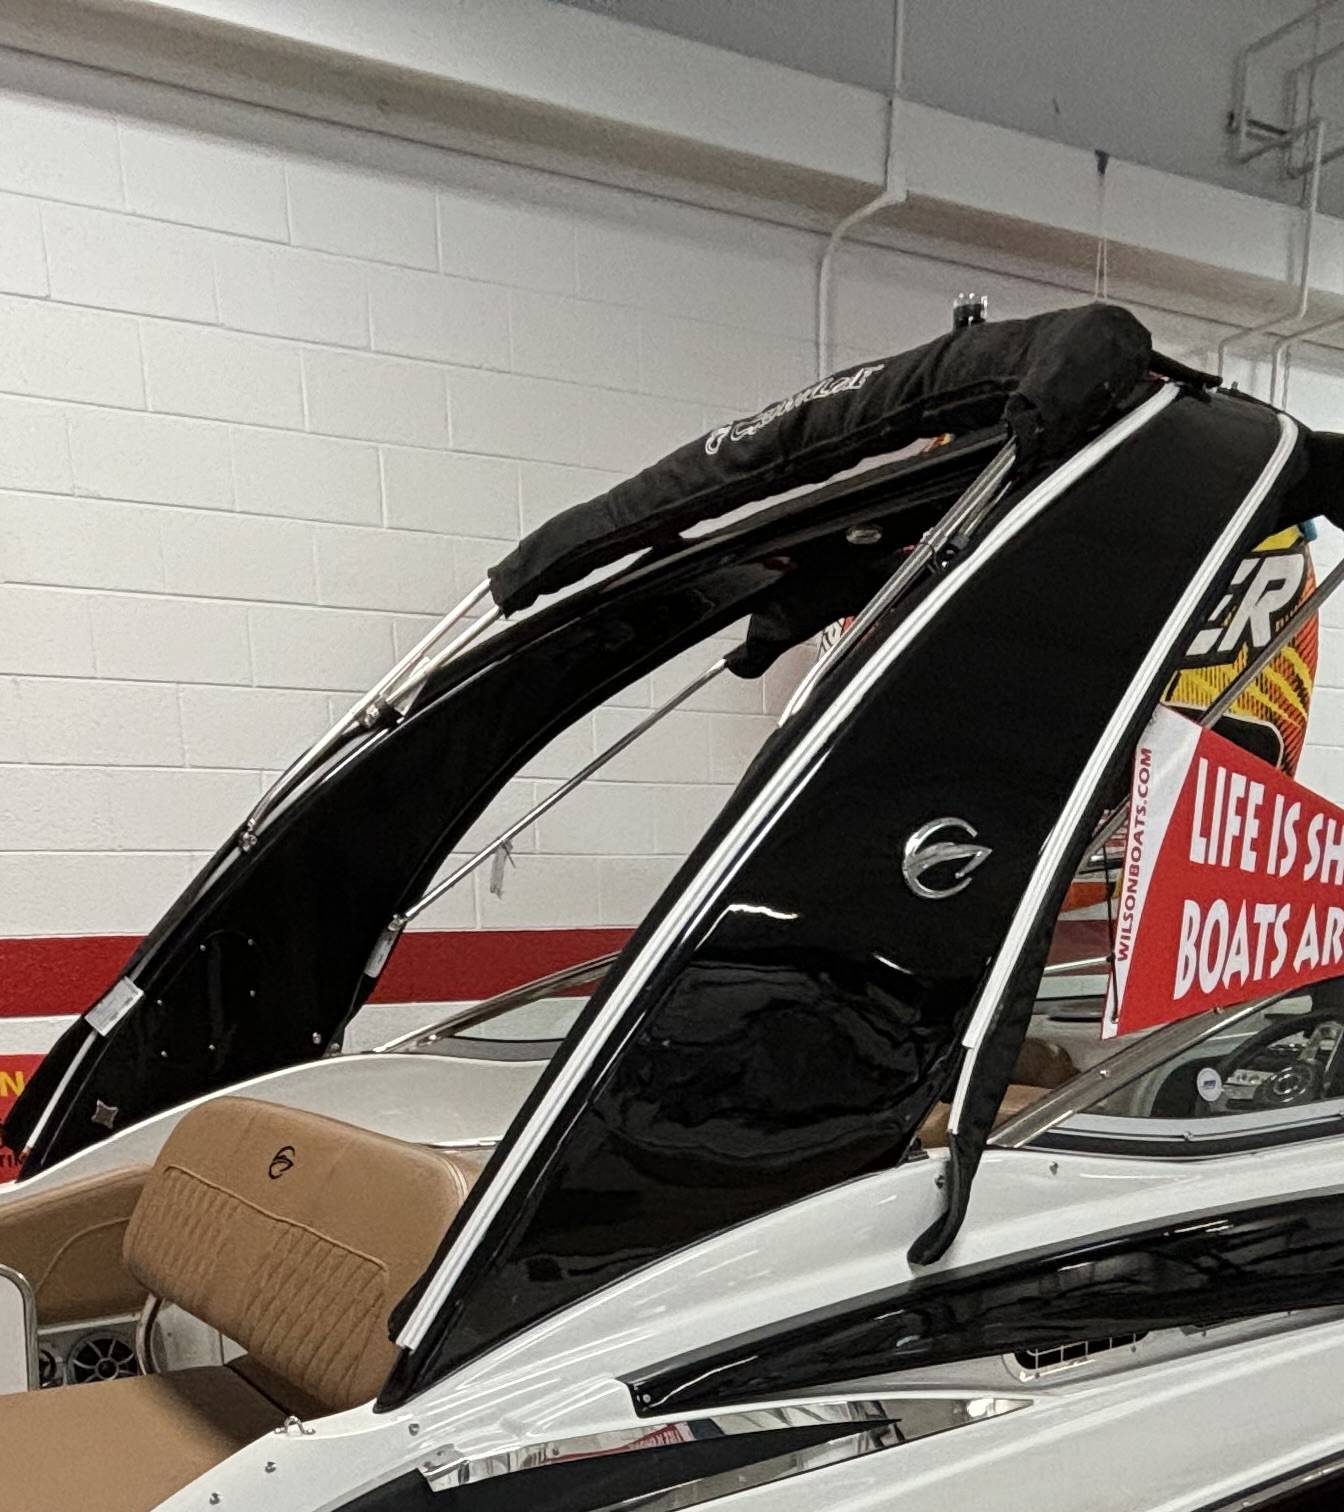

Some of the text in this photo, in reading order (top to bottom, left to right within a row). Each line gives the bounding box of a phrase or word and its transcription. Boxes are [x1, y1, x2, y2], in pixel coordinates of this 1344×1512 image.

[1117, 747, 1153, 963] WILSONBOATS.COM
[1189, 757, 1265, 874] LIFE
[1266, 794, 1302, 879] IS
[1173, 899, 1291, 1001] BOATS
